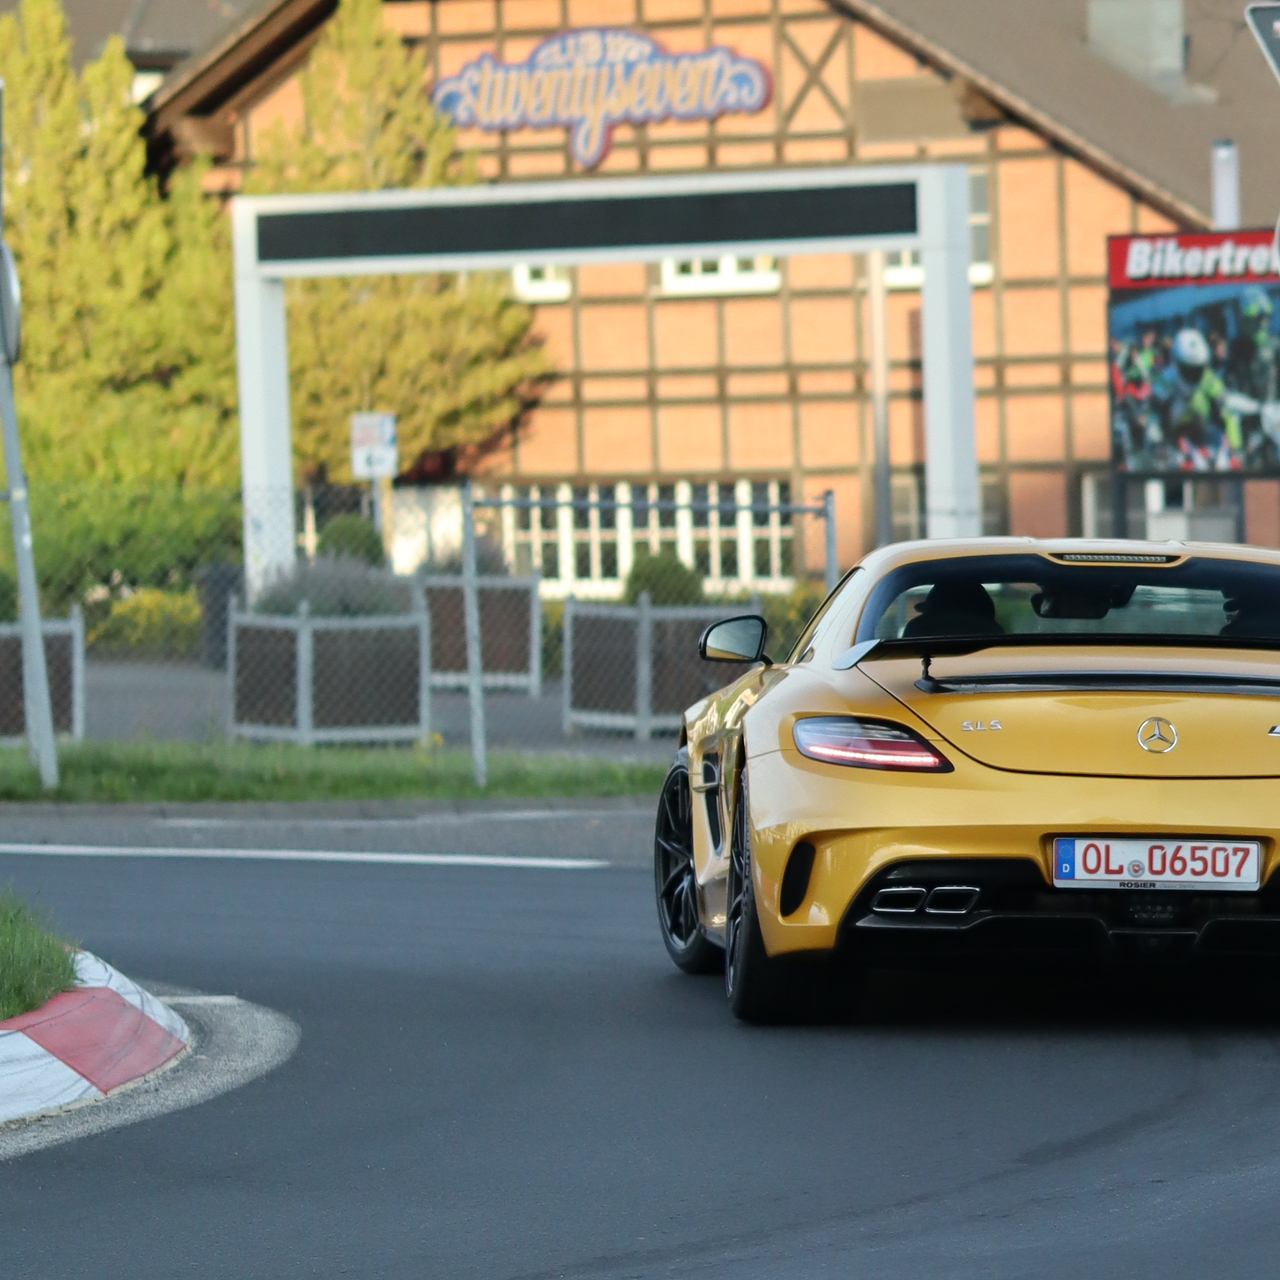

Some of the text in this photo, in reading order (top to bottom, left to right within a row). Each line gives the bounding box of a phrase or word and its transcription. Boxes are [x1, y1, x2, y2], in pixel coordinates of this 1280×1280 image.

[961, 719, 1002, 731] SLS
[1062, 842, 1251, 877] D OL 06507
[1119, 881, 1156, 889] ROSIER
